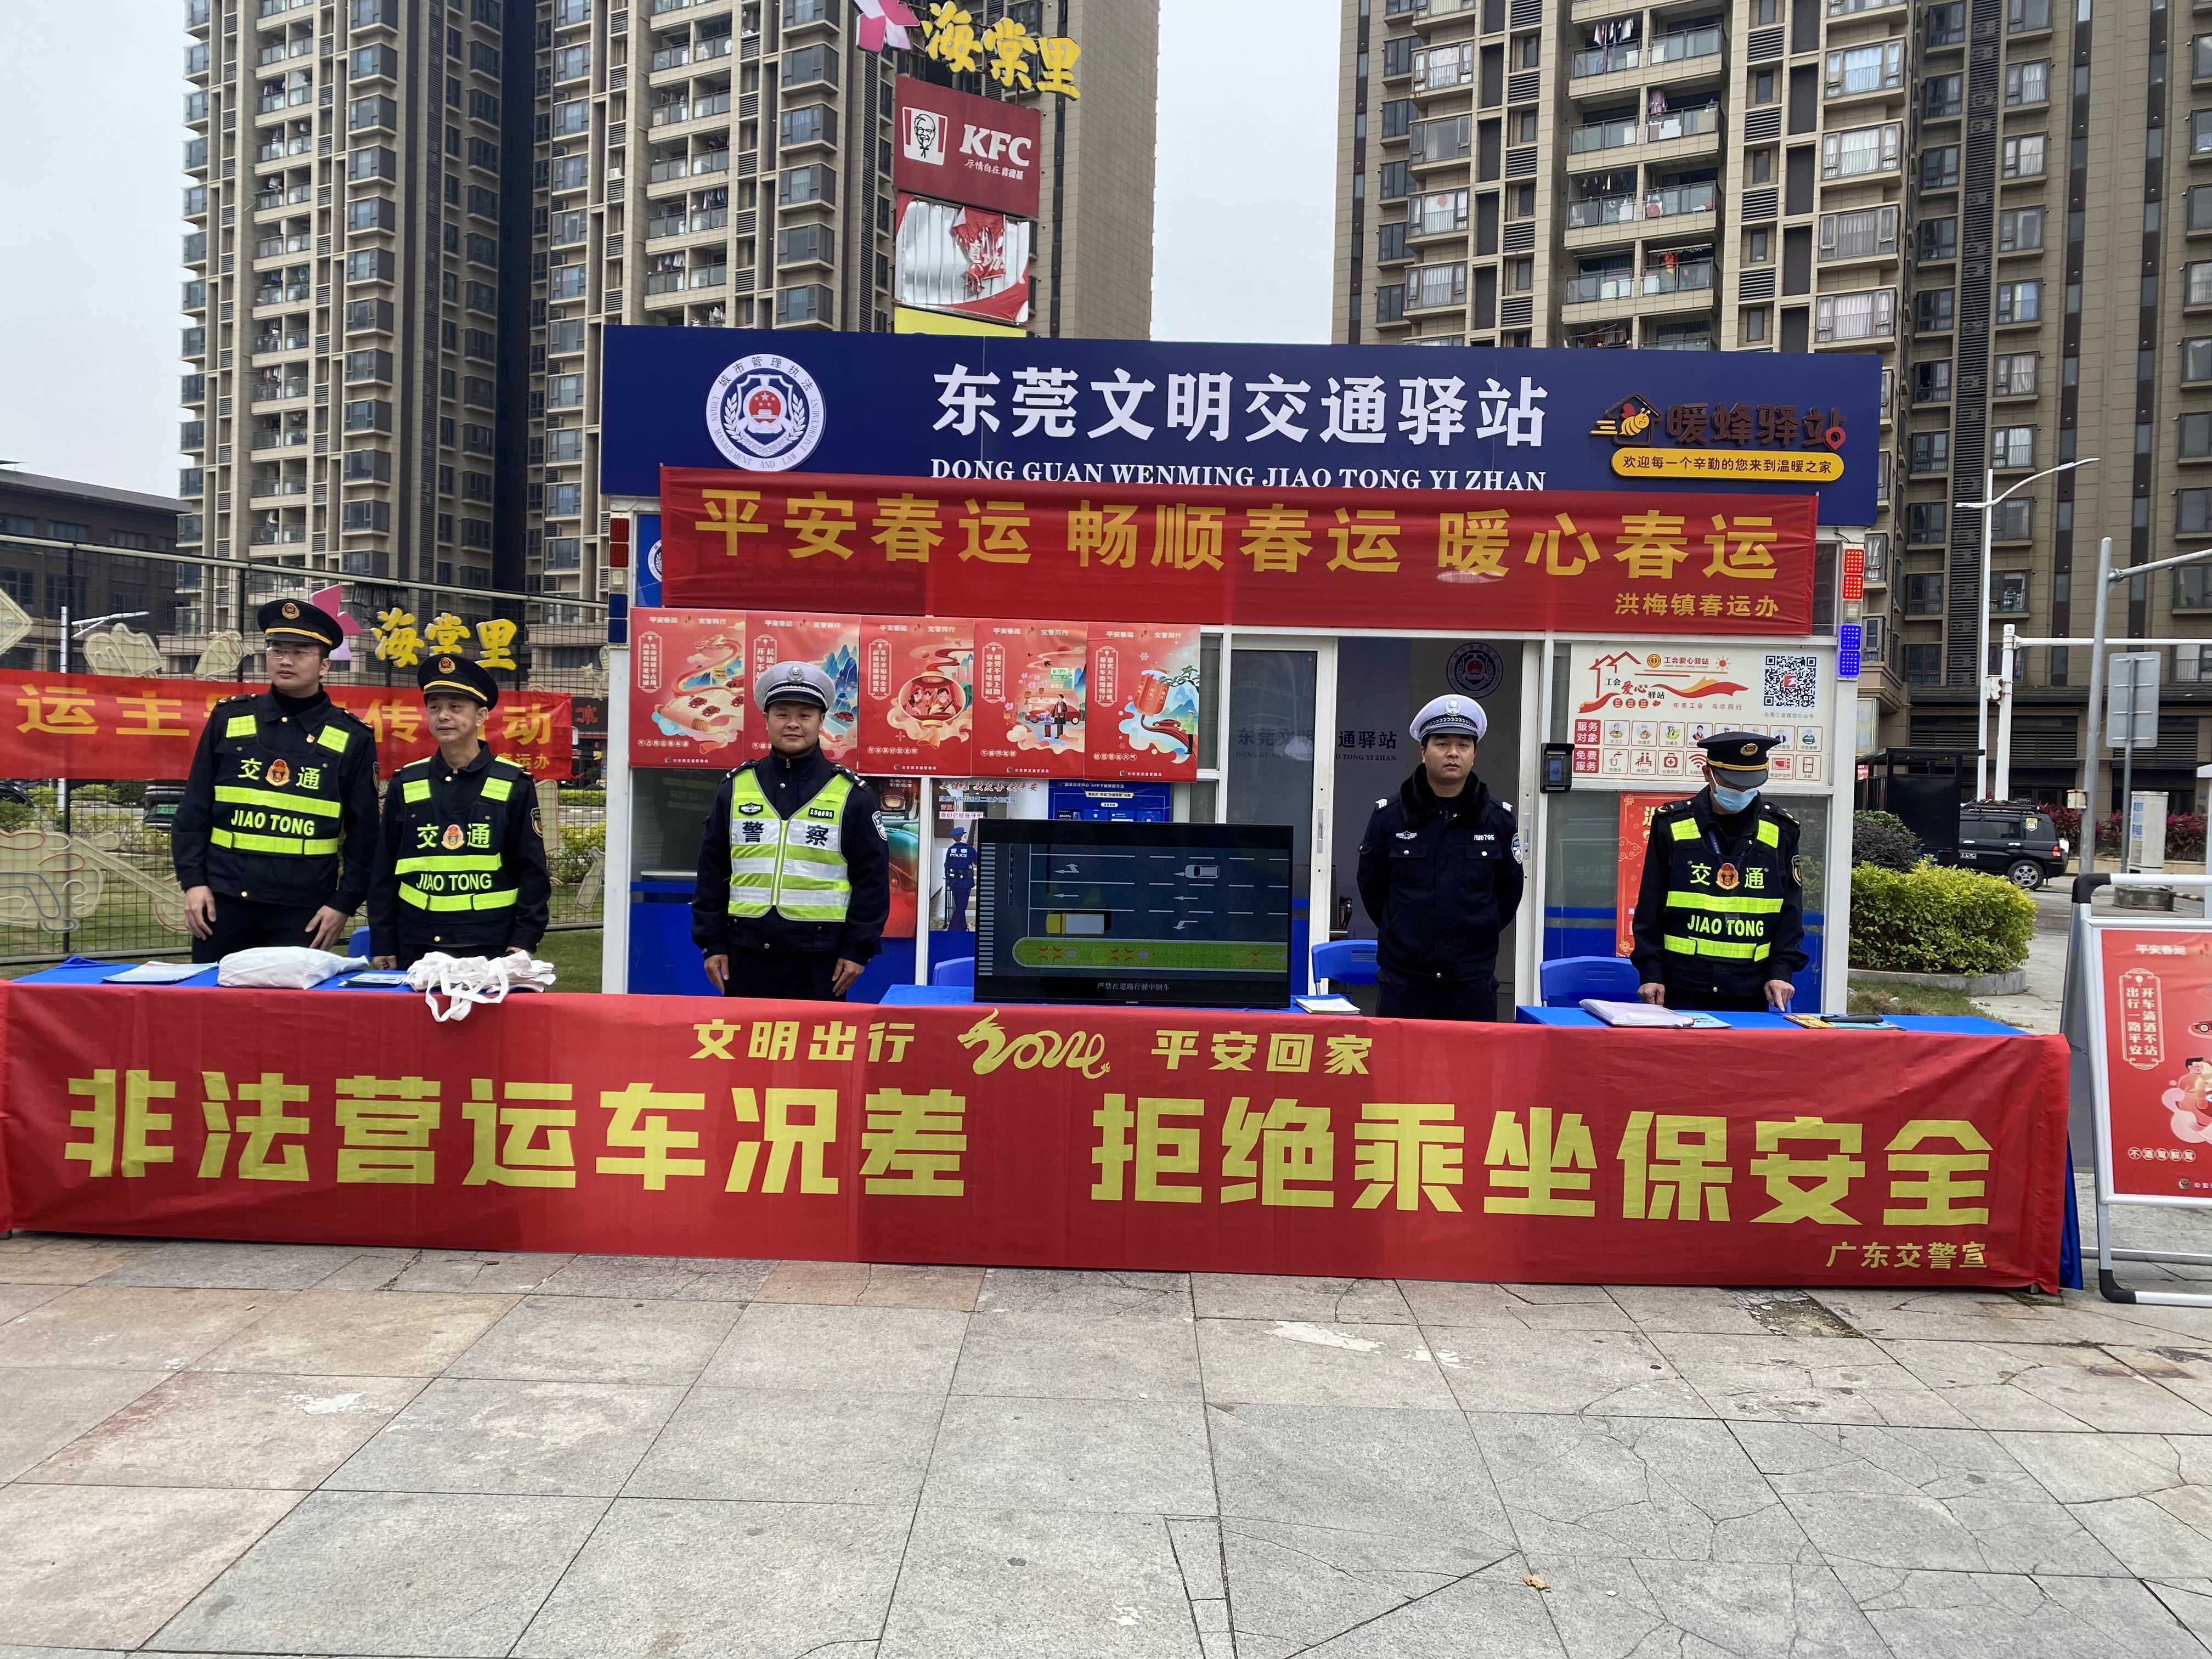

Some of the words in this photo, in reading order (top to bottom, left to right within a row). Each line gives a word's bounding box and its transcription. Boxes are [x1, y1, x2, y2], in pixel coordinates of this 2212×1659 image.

[921, 1, 1081, 101] 海棠里
[959, 123, 1031, 167] KFC
[964, 159, 1001, 174] 尽情自在
[718, 356, 814, 392] 城市管理执法
[712, 396, 720, 421] URBAN
[932, 363, 1549, 448] 东莞文明交通驿站
[800, 399, 820, 452] ENFORCEMENT
[1666, 401, 1847, 449] 暖蜂驿站
[714, 428, 753, 466] MANAGEMENT
[781, 452, 797, 465] LAW
[760, 460, 776, 469] AND
[930, 458, 1014, 481] DONG
[1023, 461, 1104, 483] GUAN
[1110, 464, 1256, 487] WENMING
[1262, 467, 1331, 489] JIAO
[1337, 469, 1422, 490] TONG
[1429, 470, 1457, 490] YI
[1465, 470, 1547, 492] ZHAN
[1622, 454, 1832, 475] 欢迎每一个辛勤的您来到温暖之家
[695, 488, 1032, 566] 平安春运
[1066, 499, 1402, 573] 畅顺春运
[1437, 508, 1778, 579] 暖心春运
[1615, 592, 1780, 618] 洪梅镇春运办
[1664, 657, 1709, 665] 工会爱心驿站
[1605, 678, 1621, 686] 工会
[1621, 680, 1648, 696] 爱心
[1647, 691, 1665, 699] 驿站
[1577, 721, 1599, 732] 服务
[1577, 733, 1598, 743] 对象
[1338, 730, 1397, 750] 通驿站
[1576, 750, 1597, 760] 免费
[1576, 761, 1597, 771] 服务
[939, 780, 970, 792] 更健康
[973, 781, 1005, 792] 更友善
[1006, 782, 1038, 792] 更平安
[230, 809, 266, 829] JIAO
[270, 814, 315, 837] TONG
[415, 873, 444, 891] JIAO
[448, 873, 492, 891] TONG
[1687, 915, 1721, 935] JIAO
[1726, 919, 1764, 937] TONG
[2135, 944, 2186, 955] 平安春运
[1097, 982, 1170, 991] 严禁在道路行驶中倒车
[2126, 987, 2142, 1056] 出行一路平安
[2142, 988, 2158, 1056] 开车滴酒不沾
[691, 1019, 915, 1063] 文明出行
[1152, 1029, 1373, 1076] 平安回家
[64, 1068, 968, 1198] 非法营运车况差
[1091, 1093, 1993, 1227] 拒绝乘坐保安全
[1826, 1240, 1988, 1271] 广东交警宣
